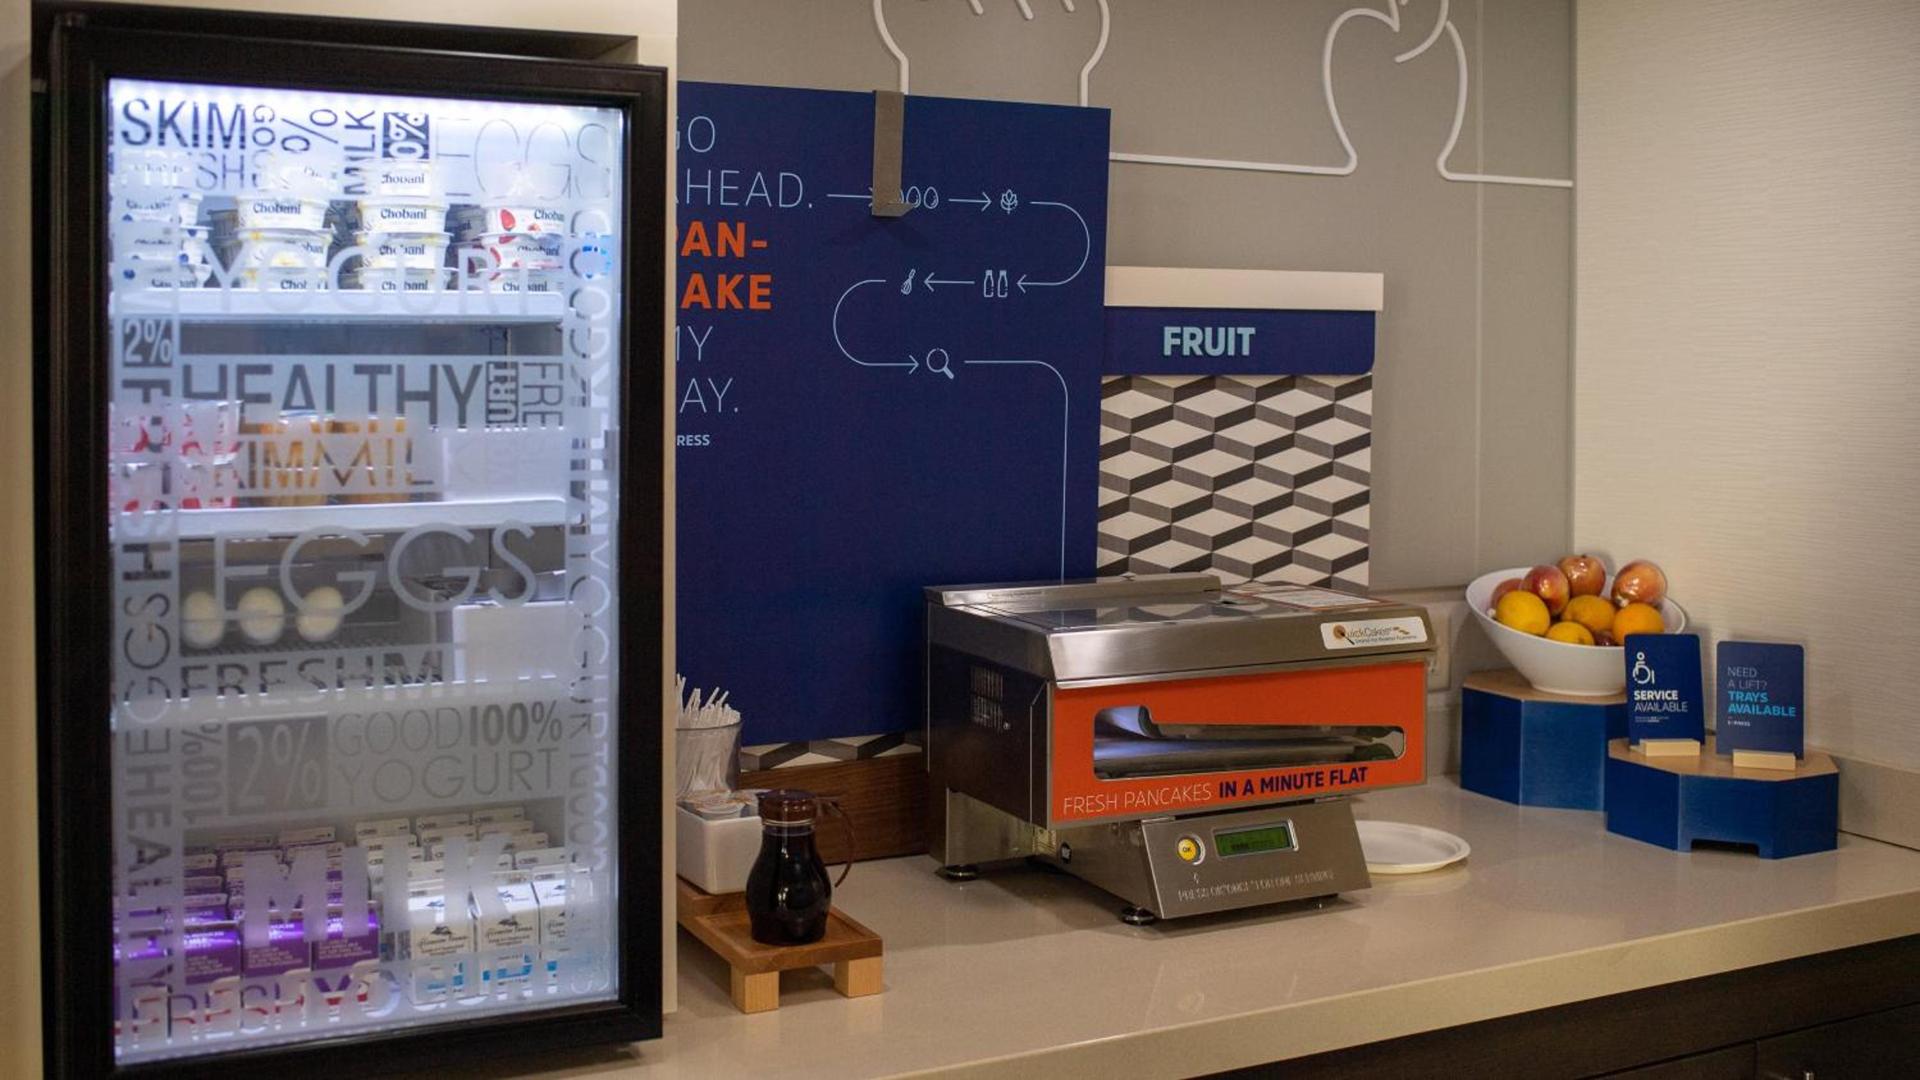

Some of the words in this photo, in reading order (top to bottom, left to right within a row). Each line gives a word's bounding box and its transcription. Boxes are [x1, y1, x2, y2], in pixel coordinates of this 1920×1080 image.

[120, 98, 247, 150] SKIM
[676, 115, 715, 153] O
[676, 168, 813, 209] HEAD.
[380, 207, 428, 220] Chobani
[533, 208, 565, 222] Choba
[676, 220, 768, 258] AN-
[381, 280, 429, 291] Chbani
[502, 280, 549, 292] Choani
[680, 272, 772, 311] AKE
[124, 319, 172, 364] 2%
[1163, 325, 1256, 357] FRUIT
[182, 362, 483, 435] HEALTHY
[680, 377, 739, 414] AY.
[214, 519, 538, 622] EGGS
[1727, 666, 1758, 678] NEED
[1727, 679, 1735, 690] A
[1633, 690, 1679, 701] SERVICE
[1634, 701, 1689, 713] AVAILABLE
[1727, 690, 1769, 703] TRAYS
[1727, 703, 1797, 717] AVAILABLE
[336, 747, 559, 806] YOGURT
[1062, 792, 1118, 815] FRESH
[1123, 782, 1213, 809] PANCAKES
[1218, 781, 1237, 798] IN
[1242, 779, 1255, 796] A
[1260, 770, 1325, 793] MINUTE
[1330, 766, 1368, 785] FLAT
